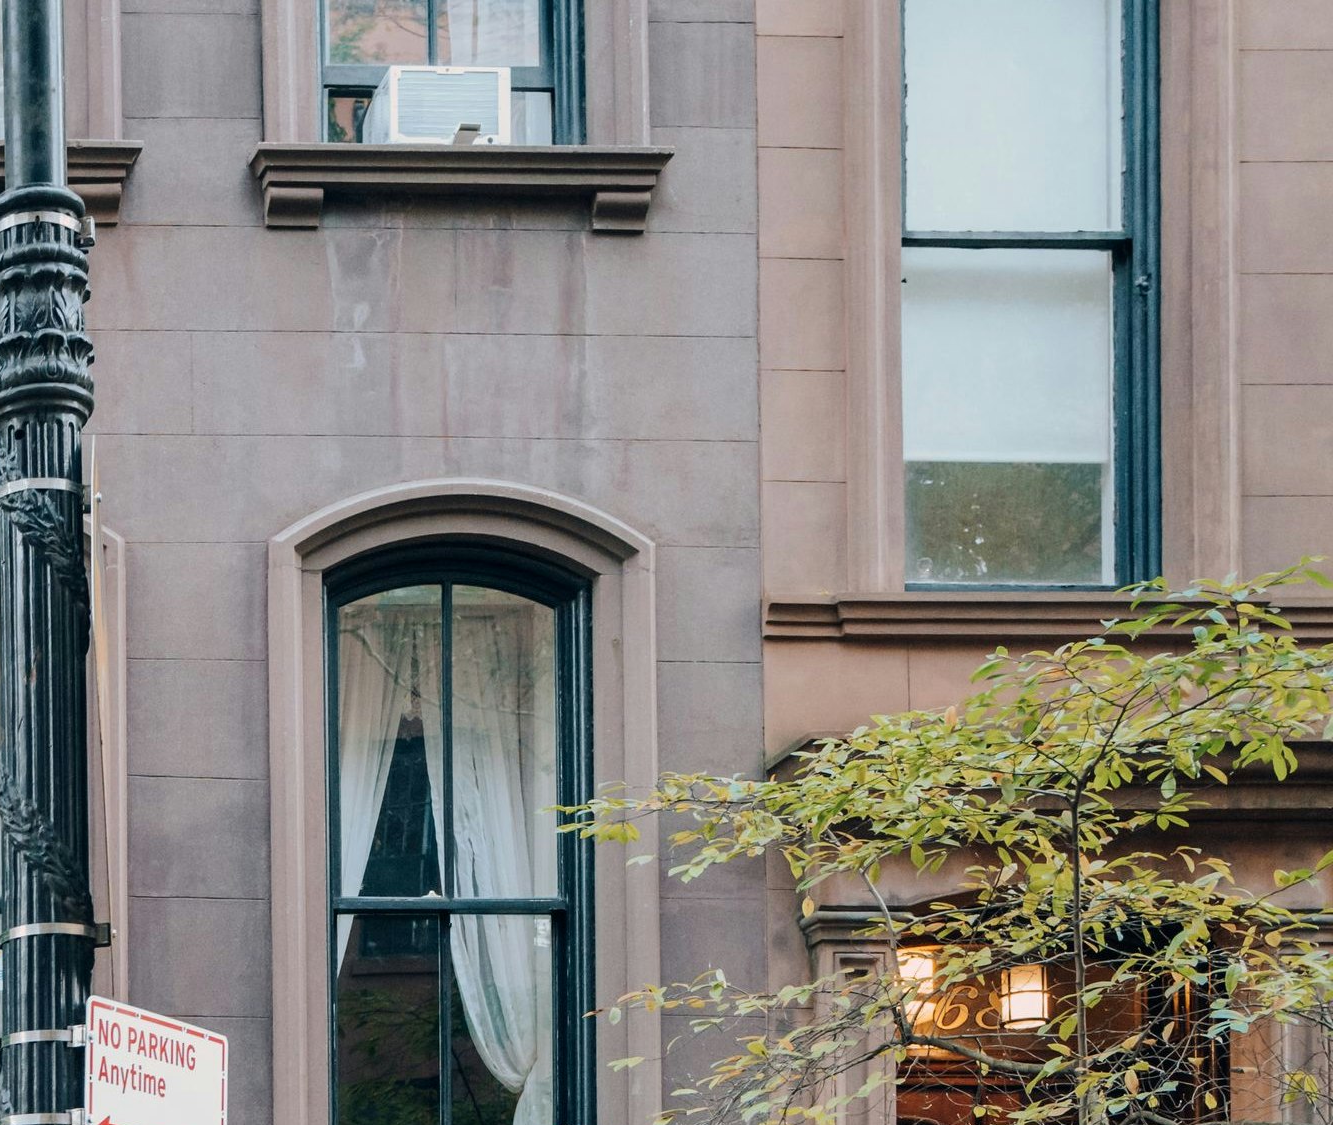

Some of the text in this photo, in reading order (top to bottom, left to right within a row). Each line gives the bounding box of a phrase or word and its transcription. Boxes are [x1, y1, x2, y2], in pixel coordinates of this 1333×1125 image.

[98, 1019, 196, 1071] NO PARKING
[98, 1056, 167, 1098] Anytime
